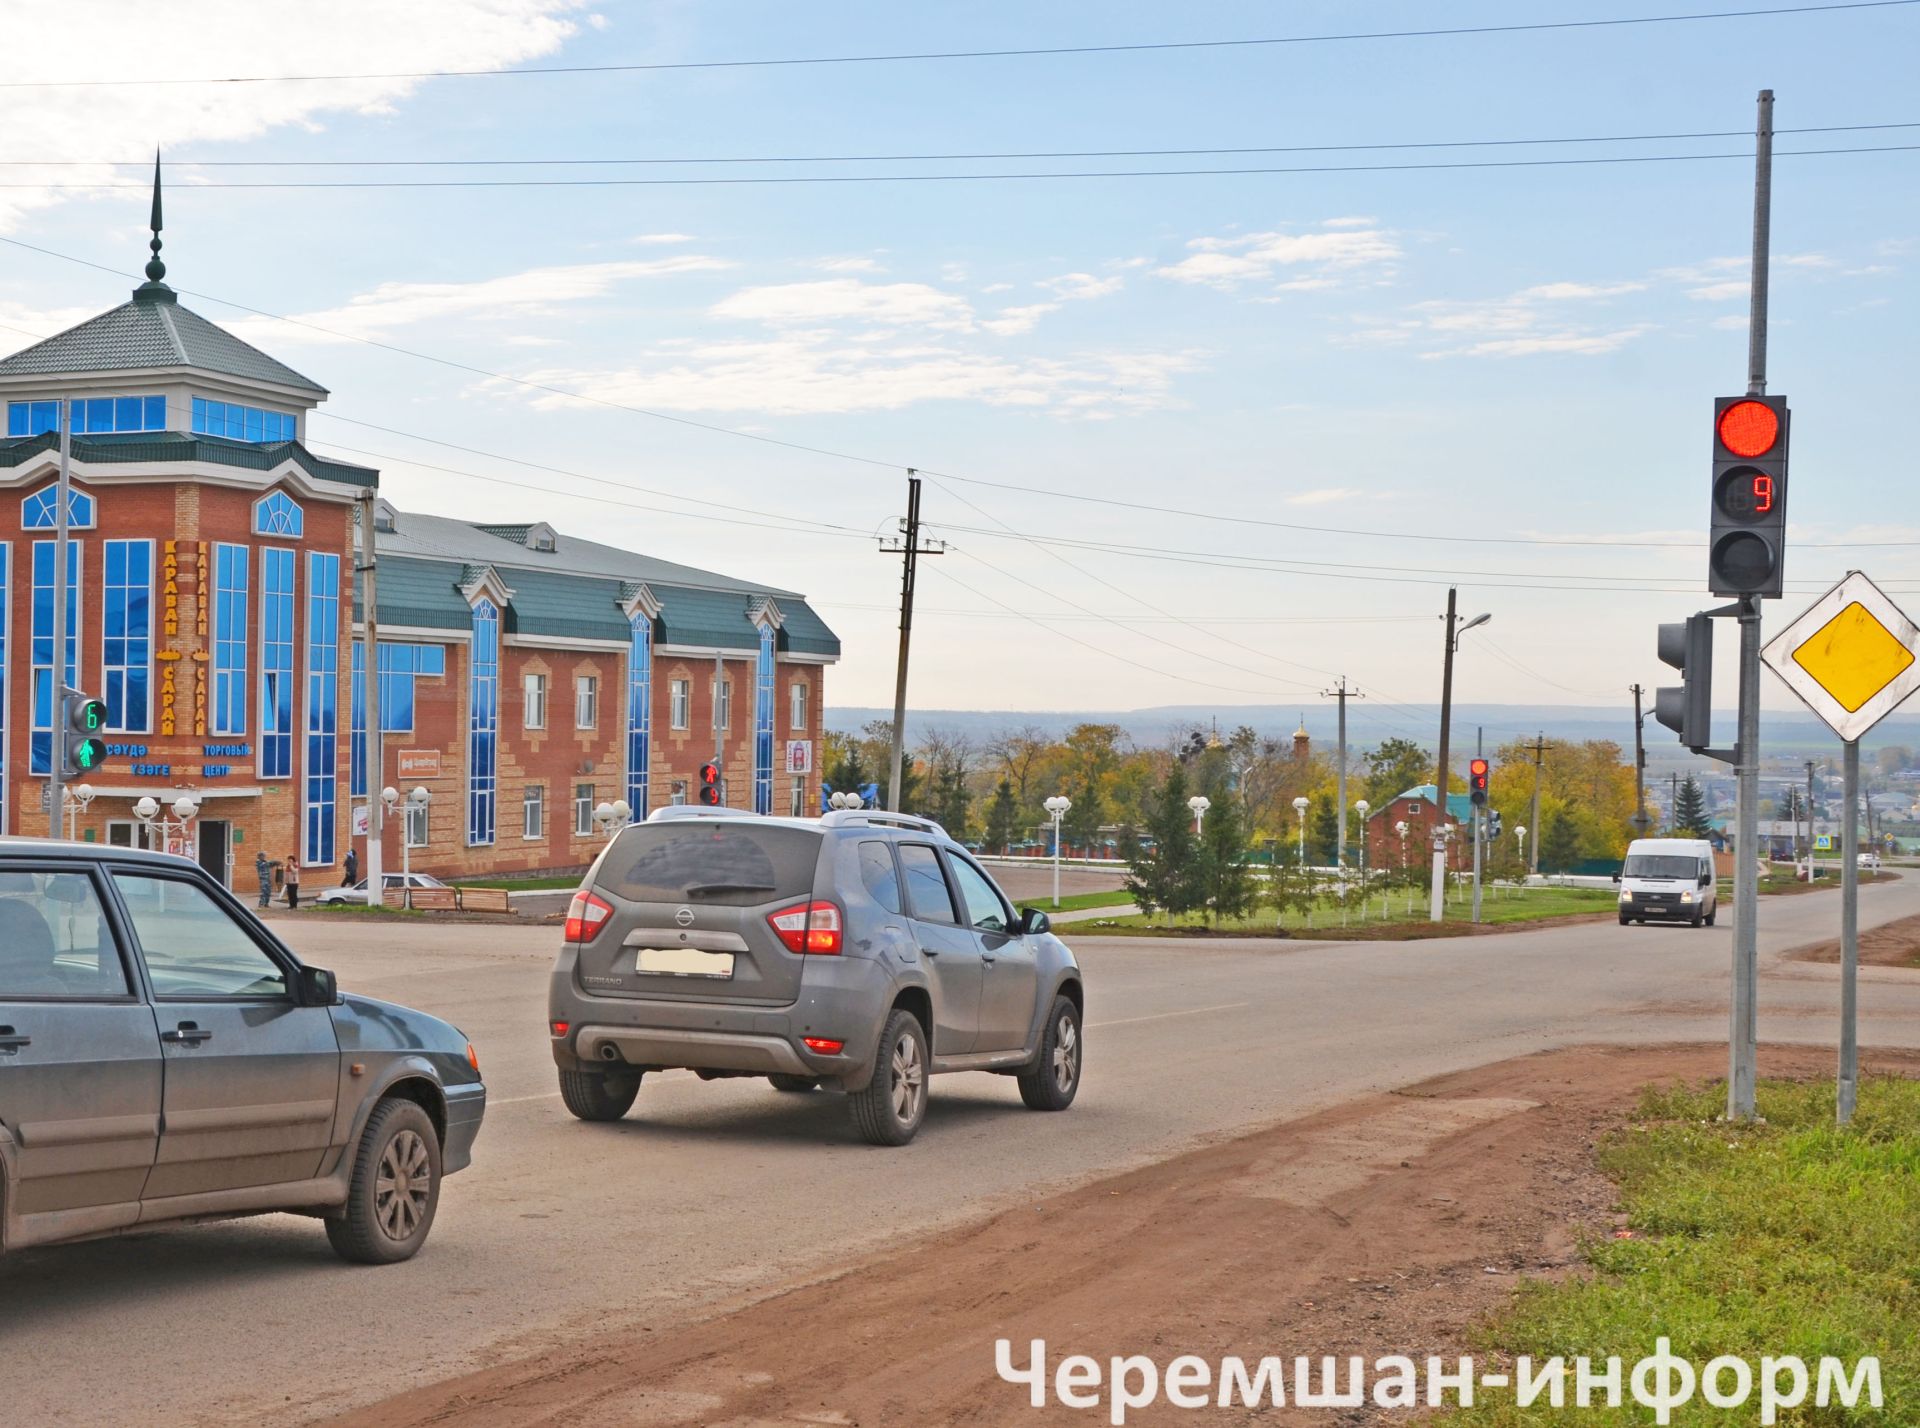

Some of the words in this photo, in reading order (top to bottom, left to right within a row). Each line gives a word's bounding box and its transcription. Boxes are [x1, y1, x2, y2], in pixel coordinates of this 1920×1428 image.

[1753, 475, 1773, 512] 9
[163, 540, 178, 635] КАРАВАН
[197, 541, 208, 635] КАРАВАН
[87, 703, 98, 729] 6
[160, 666, 176, 736] САРАЙ
[195, 667, 206, 736] САРАЙ
[203, 742, 250, 757] ТОРГОВЫЙ
[203, 764, 232, 778] ЦЕНТР
[710, 787, 719, 805] 9
[583, 976, 623, 985] TERRANO
